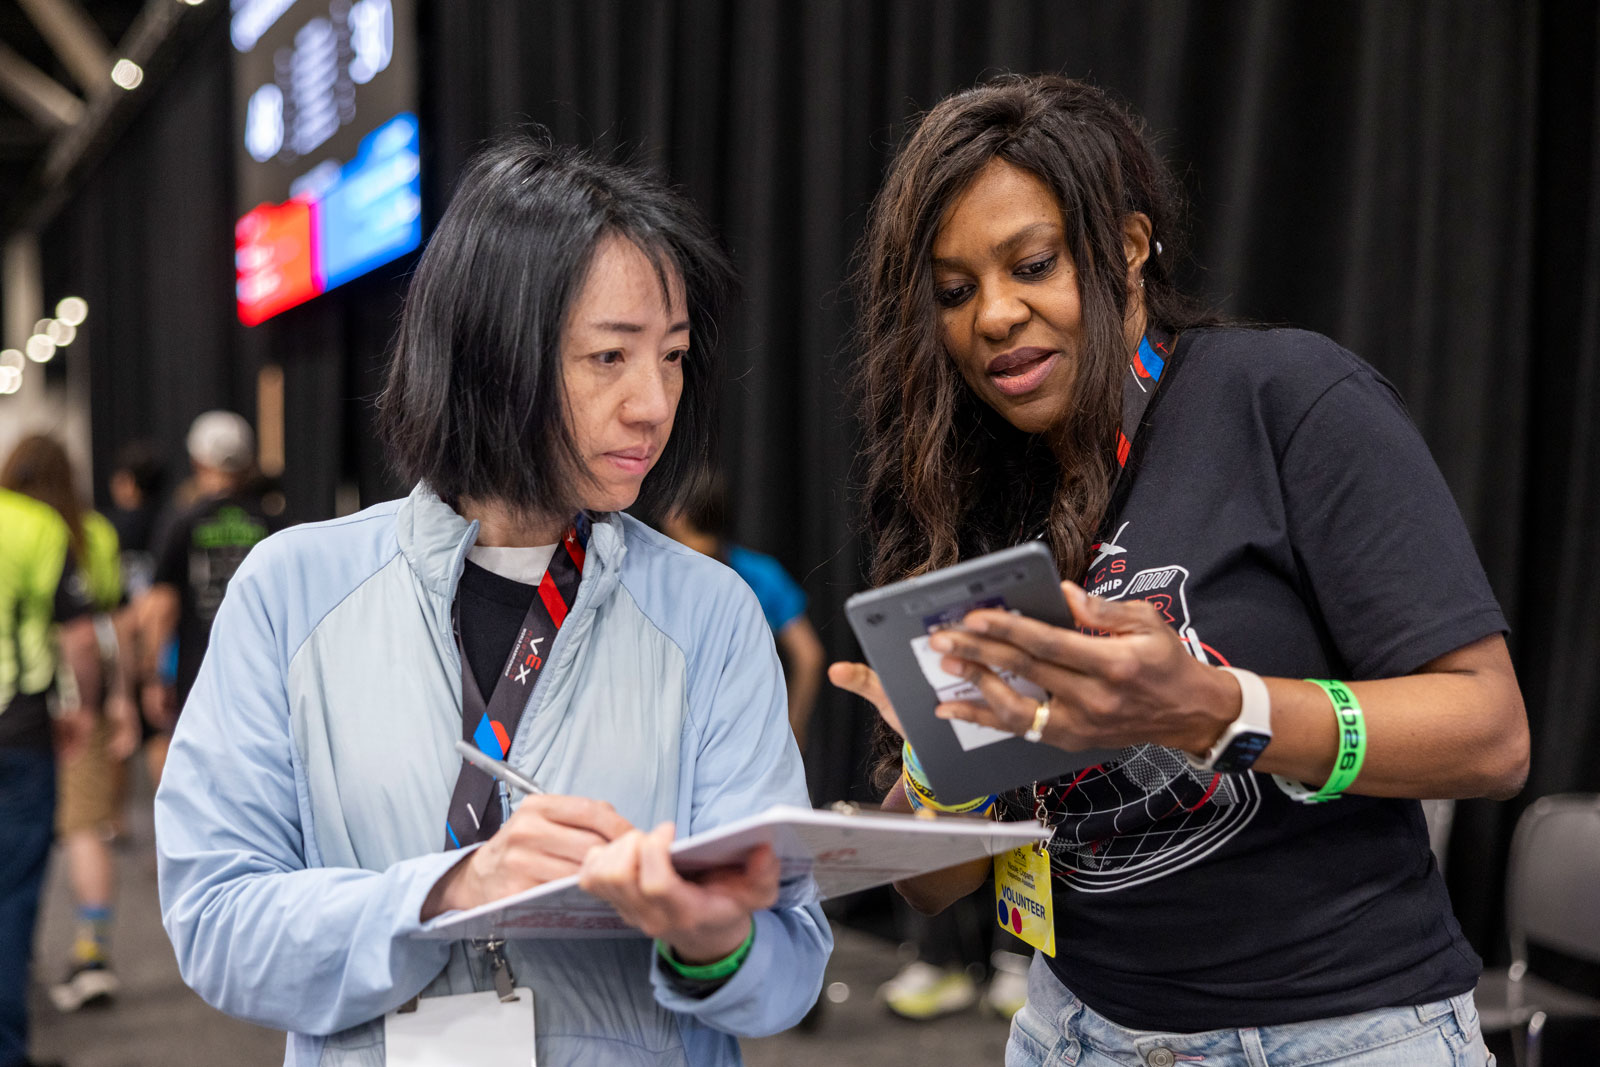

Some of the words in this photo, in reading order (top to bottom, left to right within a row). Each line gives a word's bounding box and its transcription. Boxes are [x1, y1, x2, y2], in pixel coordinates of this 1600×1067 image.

[514, 637, 545, 685] VEX
[1328, 687, 1359, 771] 2026
[1001, 883, 1047, 921] VOLUNTEER
